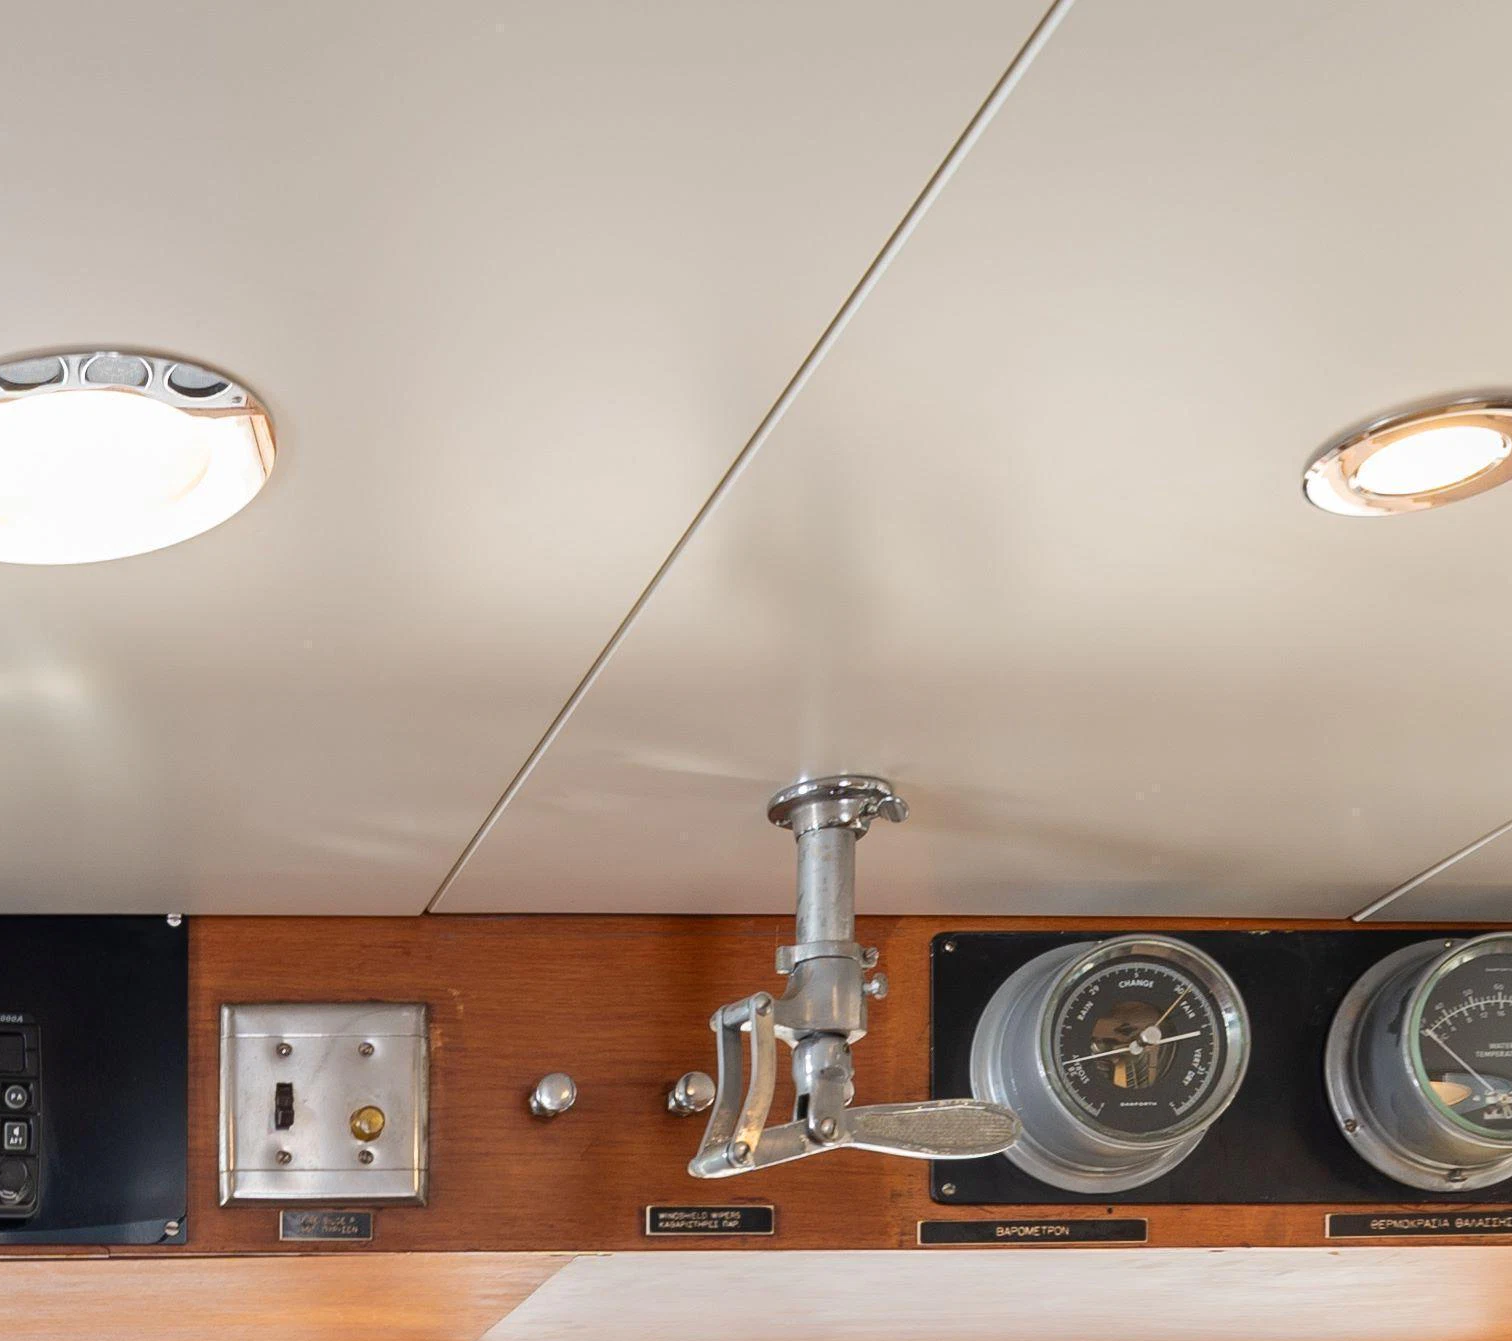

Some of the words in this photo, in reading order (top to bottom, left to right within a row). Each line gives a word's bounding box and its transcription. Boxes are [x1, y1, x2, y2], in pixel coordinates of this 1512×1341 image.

[1118, 980, 1155, 989] CHANGE
[1077, 1000, 1094, 1021] RAIN
[1180, 1000, 1196, 1019] FAIR
[1370, 1219, 1450, 1230] ΘΕΡΜΟΚΡΑΣΙΑ
[996, 1225, 1070, 1237] ΒΑΡΟΜΕΤΡΟΝ
